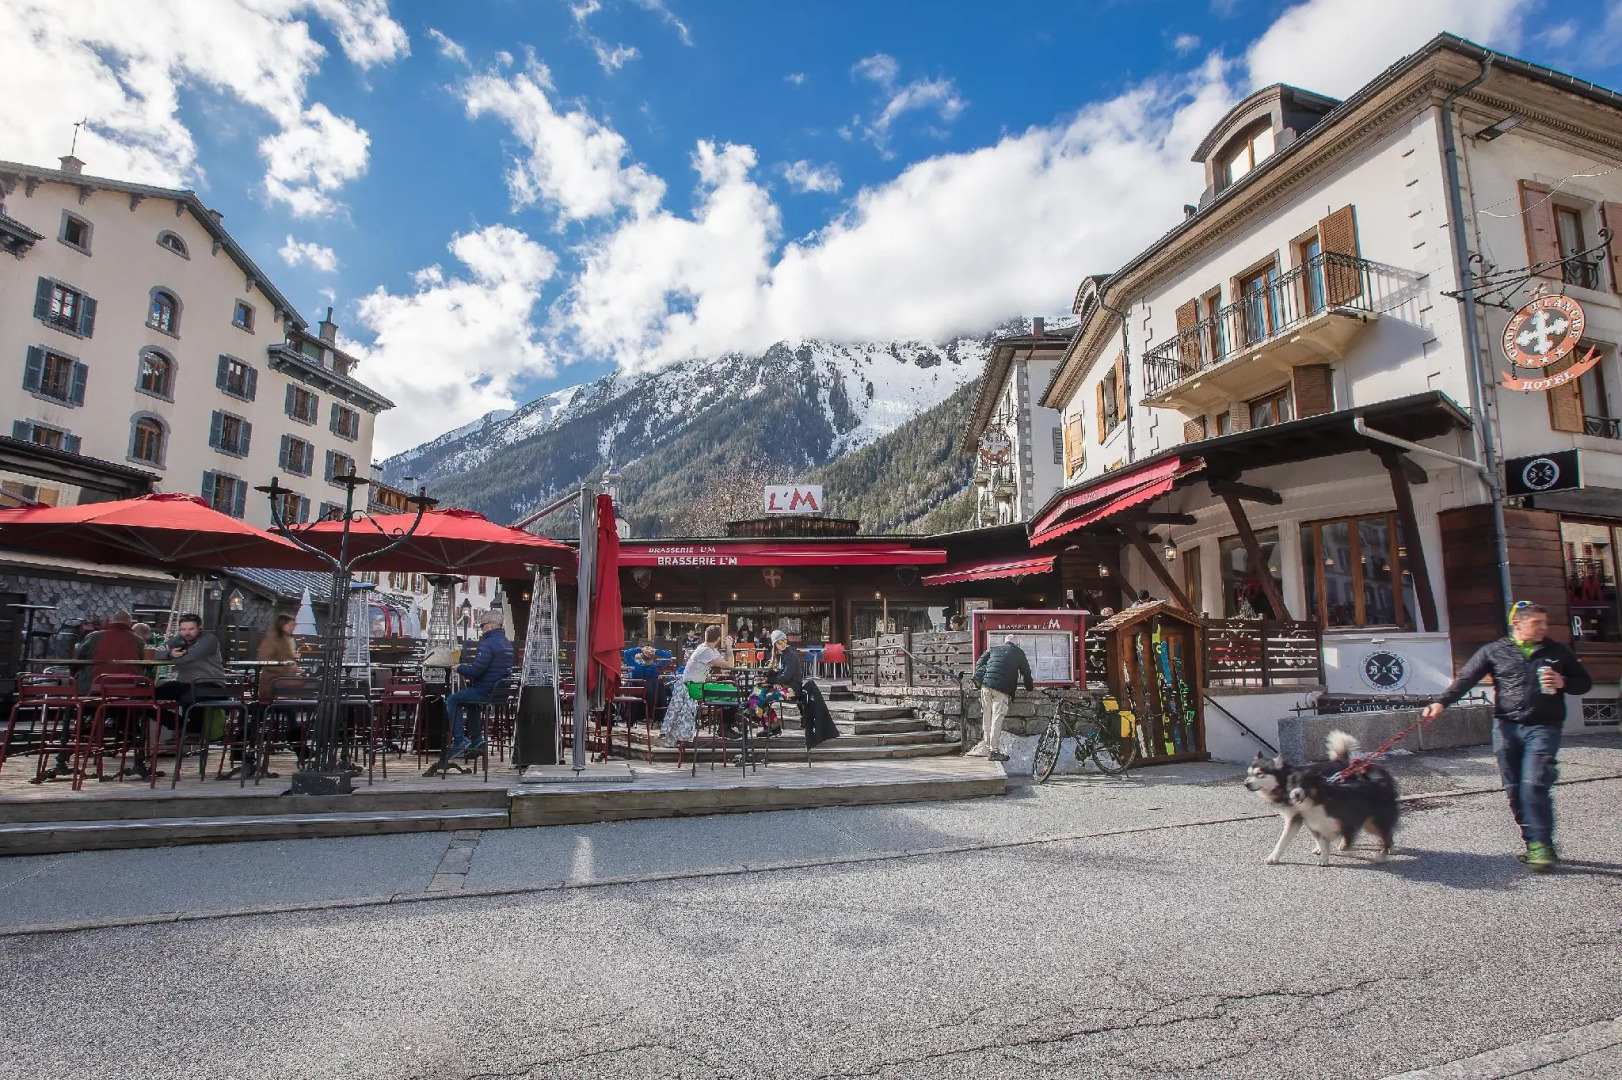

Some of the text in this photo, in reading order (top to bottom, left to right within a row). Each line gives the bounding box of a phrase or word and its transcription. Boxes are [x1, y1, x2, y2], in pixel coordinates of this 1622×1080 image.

[1504, 299, 1582, 358] CROIX BLANCHE
[1522, 371, 1574, 390] HOTEL
[768, 487, 819, 511] L'M
[657, 556, 738, 566] BRASSERIE L'M
